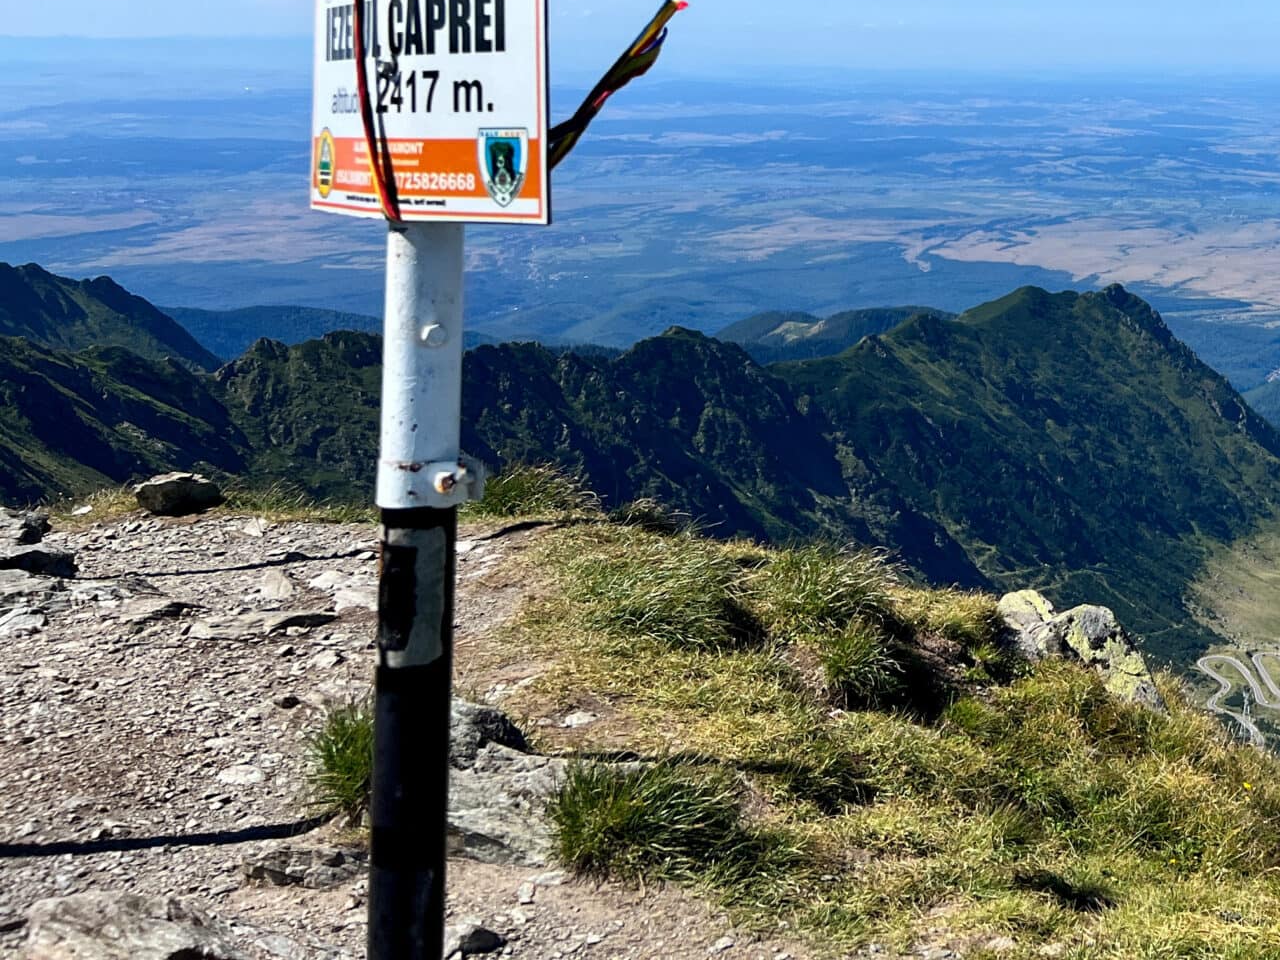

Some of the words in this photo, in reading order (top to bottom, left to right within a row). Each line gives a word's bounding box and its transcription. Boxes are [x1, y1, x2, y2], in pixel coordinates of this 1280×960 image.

[326, 0, 381, 62] IEZEUL
[376, 70, 440, 113] 2417
[453, 80, 494, 112] m.
